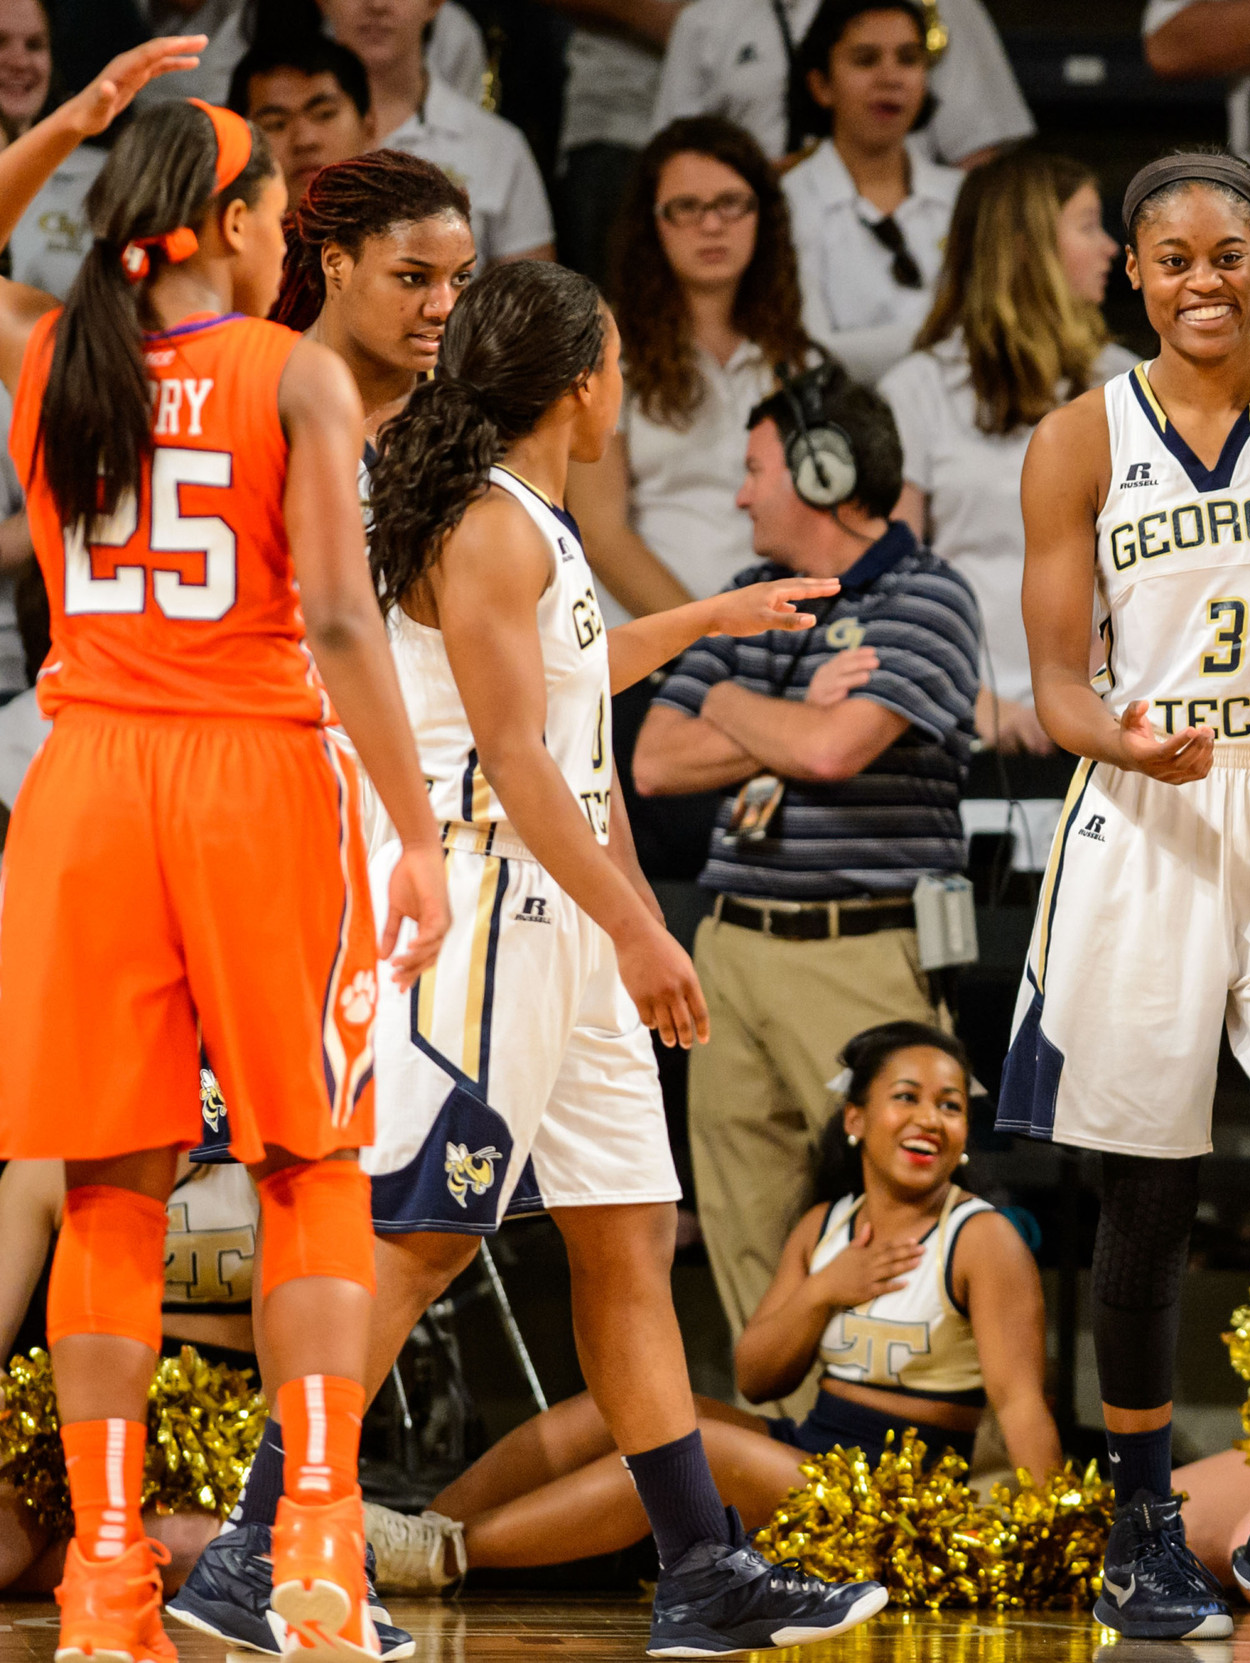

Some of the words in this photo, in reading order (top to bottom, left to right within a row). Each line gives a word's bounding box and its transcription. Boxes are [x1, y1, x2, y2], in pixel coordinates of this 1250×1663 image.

[1120, 480, 1159, 489] RUSSELL
[63, 447, 237, 622] 25
[1200, 596, 1248, 677] 3
[1078, 828, 1106, 842] RUSSELL
